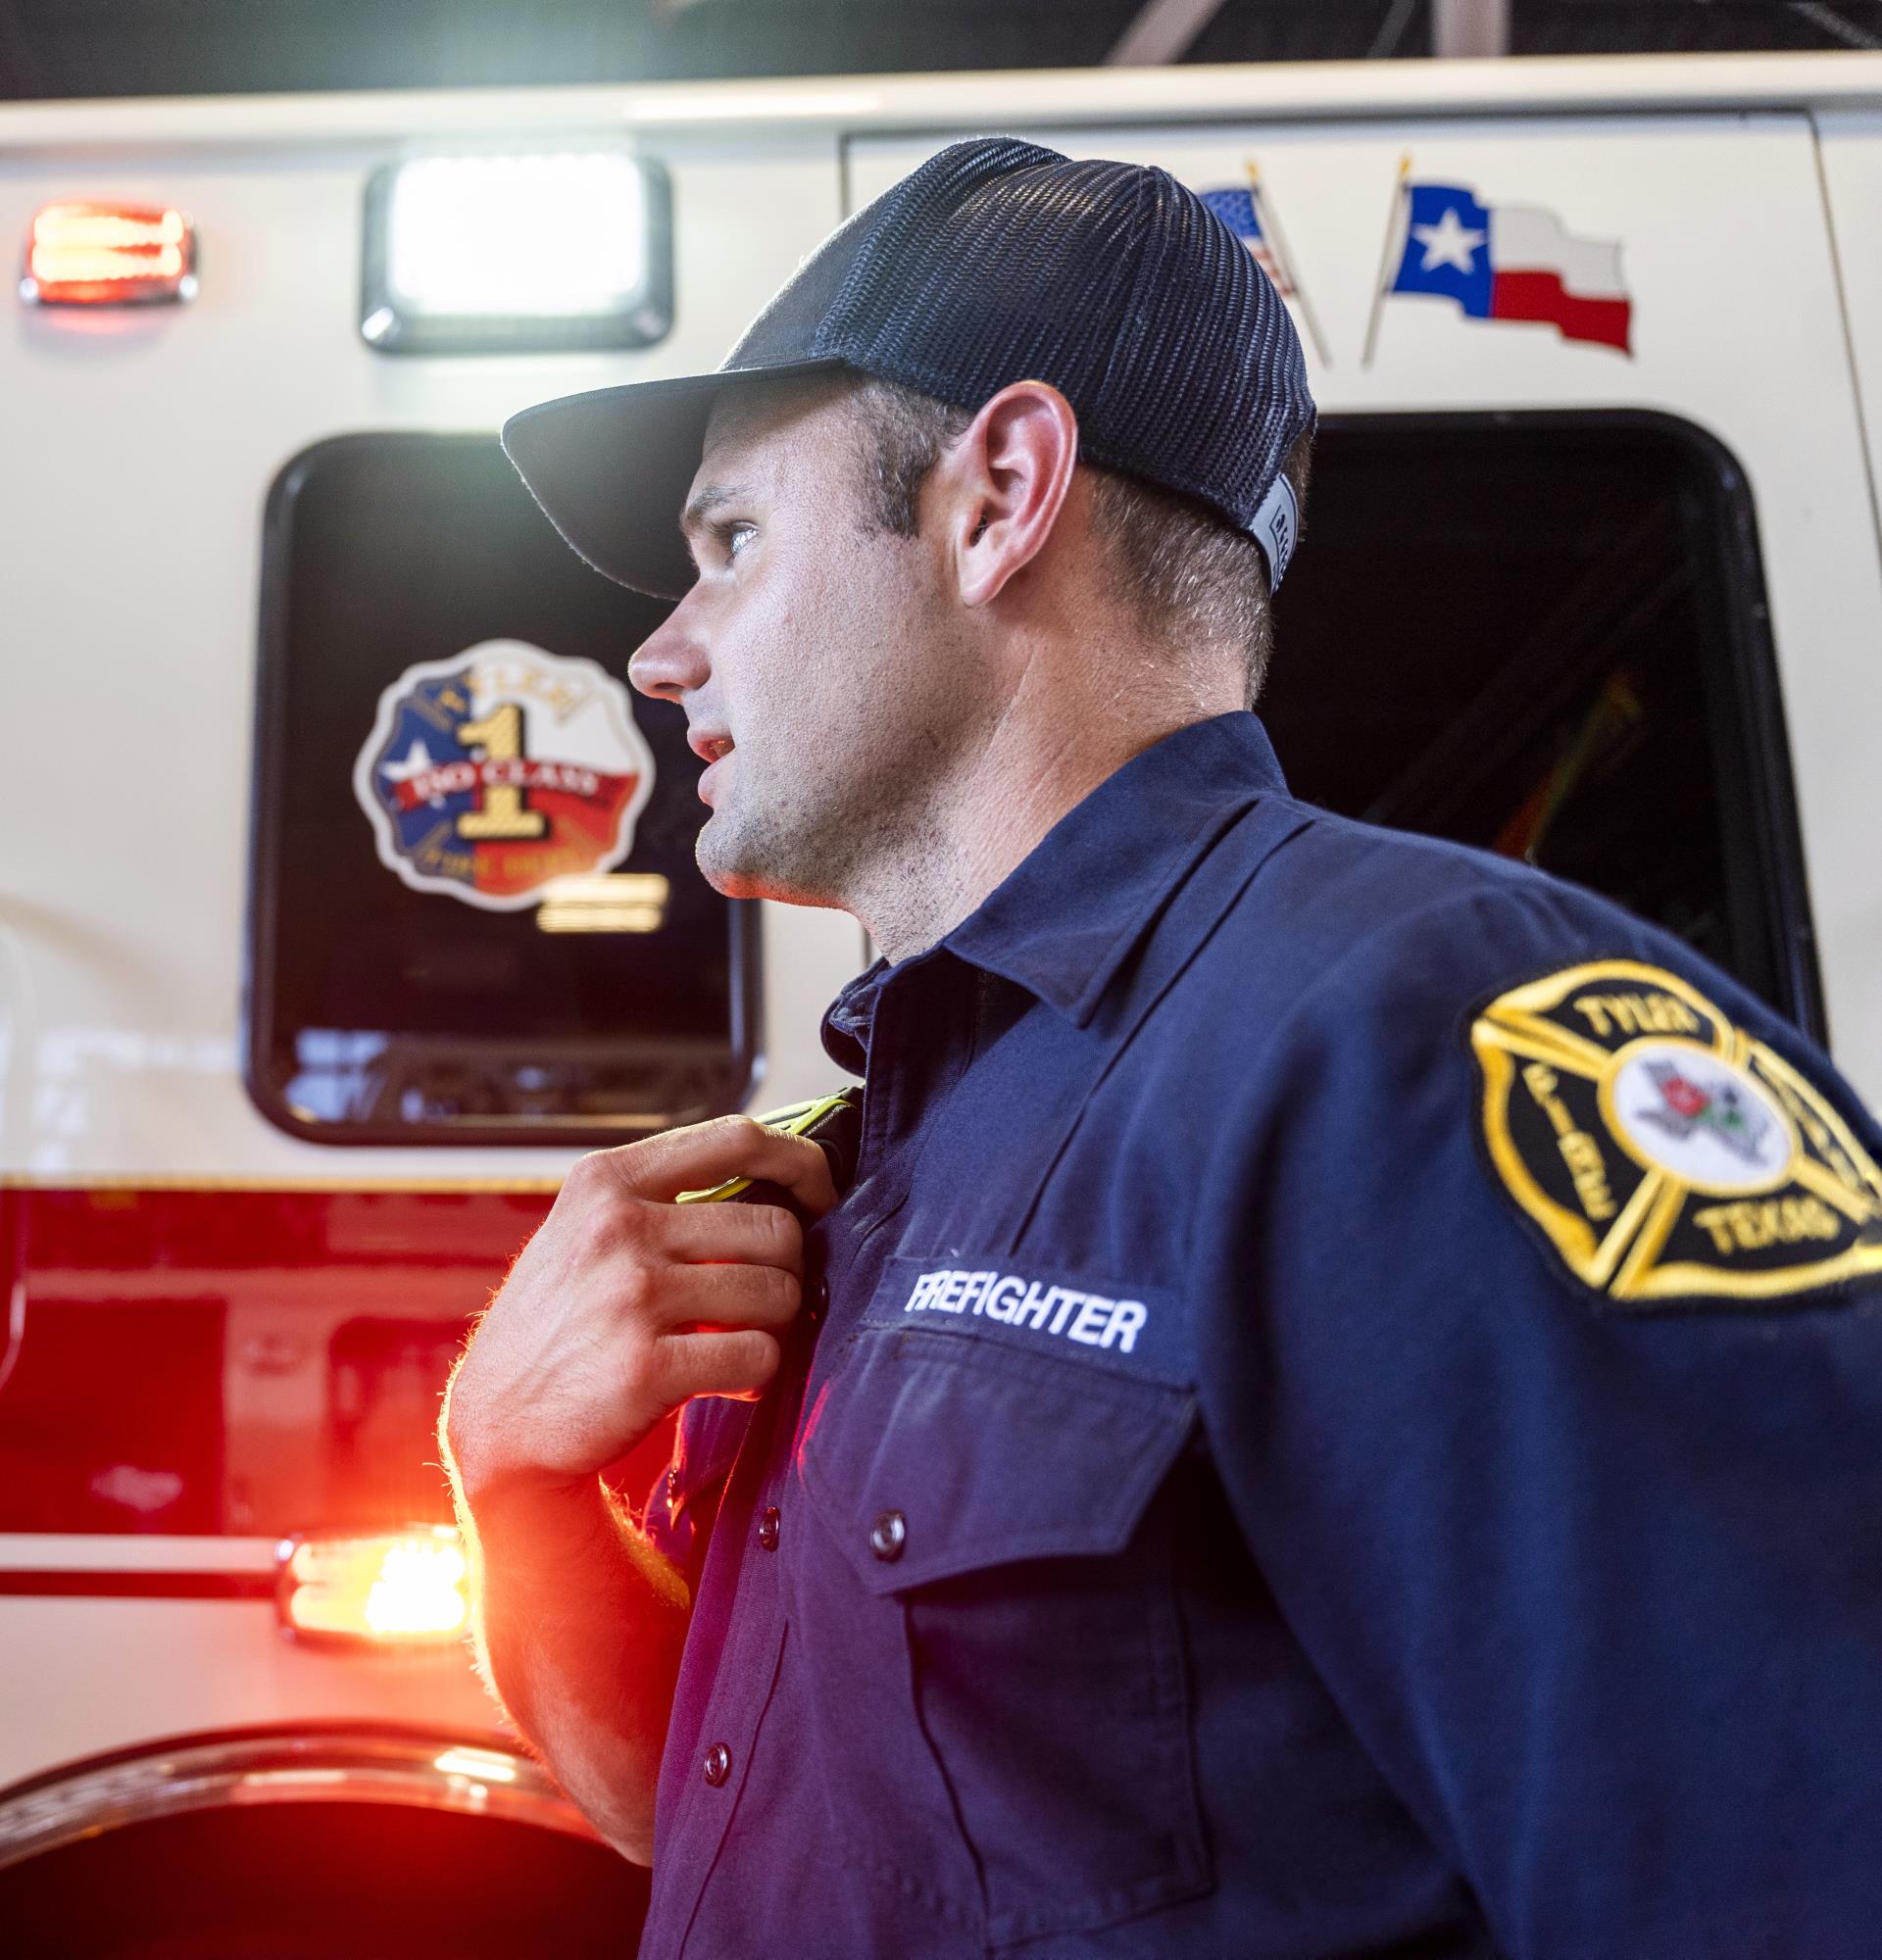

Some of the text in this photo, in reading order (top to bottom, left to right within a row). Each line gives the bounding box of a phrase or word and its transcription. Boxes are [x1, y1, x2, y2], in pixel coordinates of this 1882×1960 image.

[458, 703, 544, 840] 1
[481, 760, 599, 796] CLASS
[1692, 1197, 1841, 1255] TEXAS
[904, 1270, 1148, 1353] FIREFIGHTER
